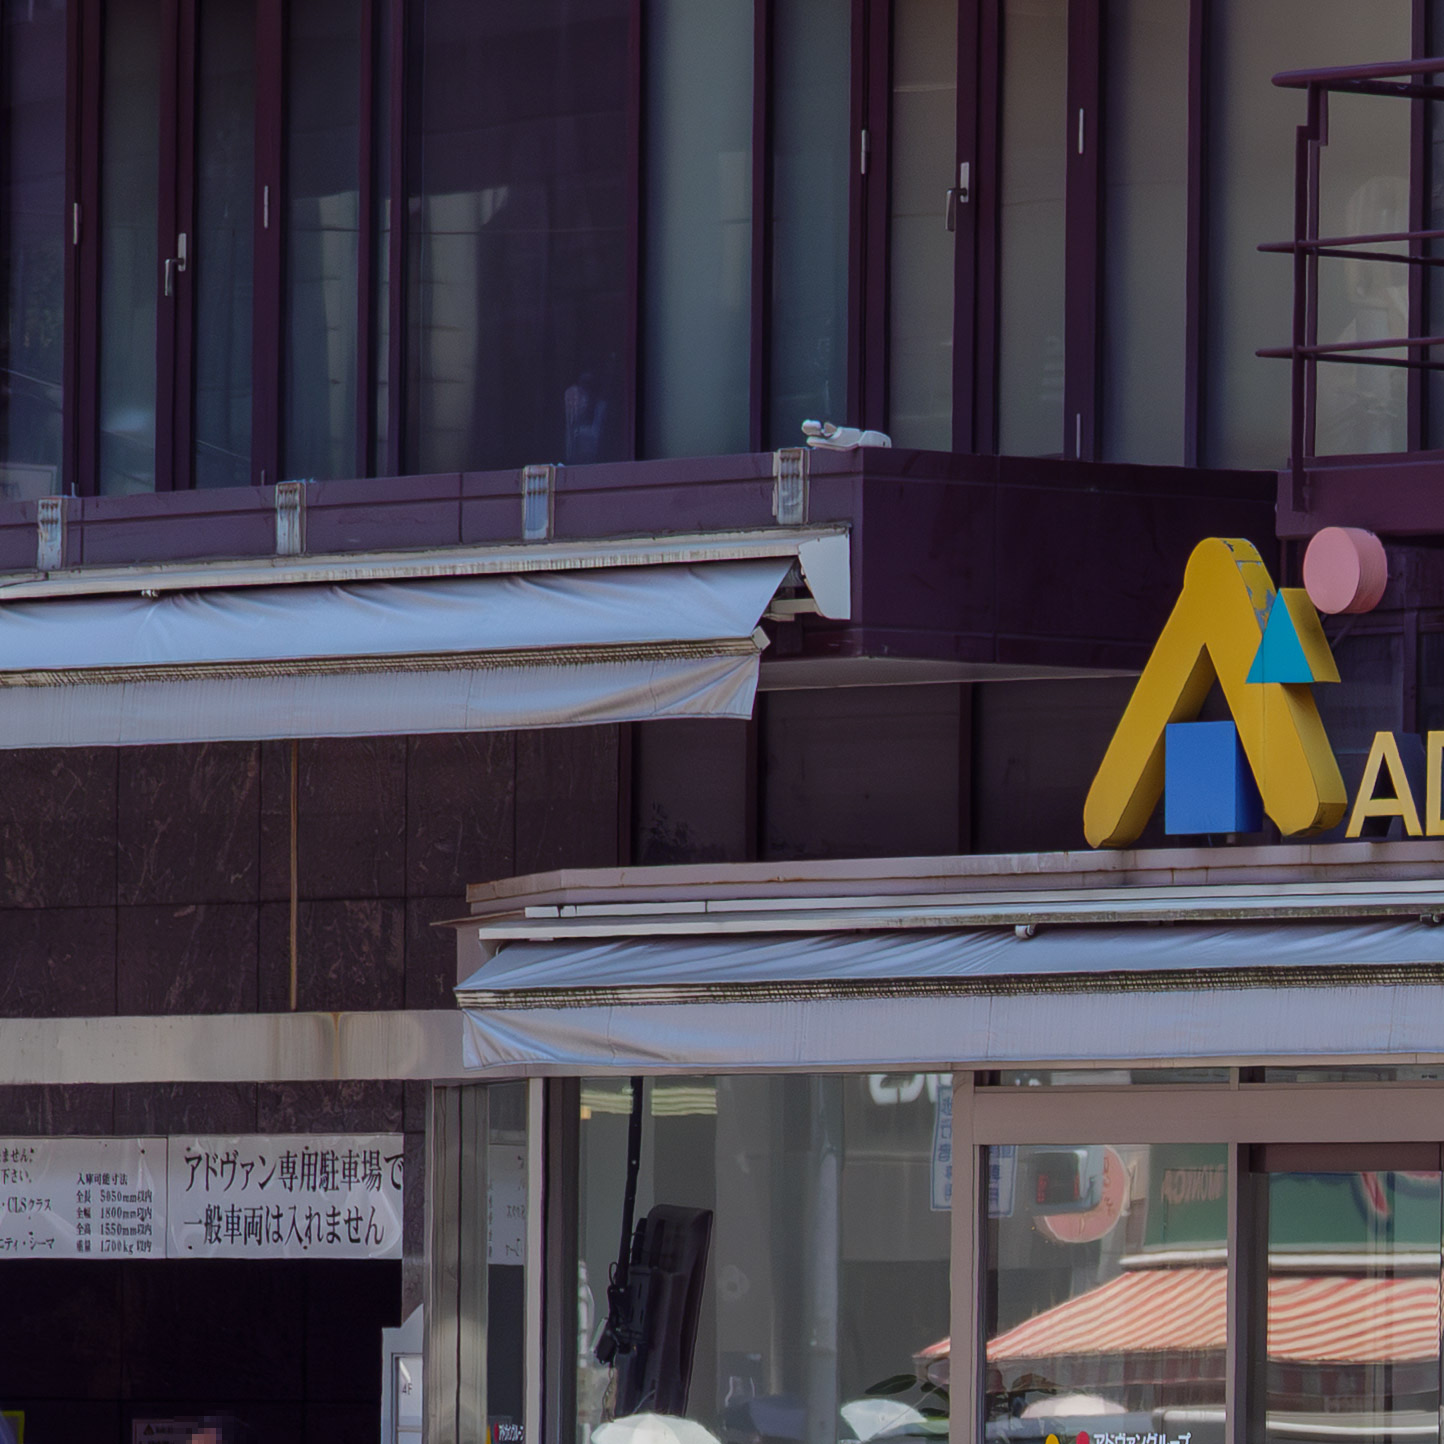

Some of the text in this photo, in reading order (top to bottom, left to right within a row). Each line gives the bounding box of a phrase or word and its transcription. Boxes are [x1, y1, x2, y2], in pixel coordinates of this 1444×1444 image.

[184, 1149, 404, 1193] アドヴァン専用駐車場で
[184, 1203, 385, 1246] 一般車両は入れません
